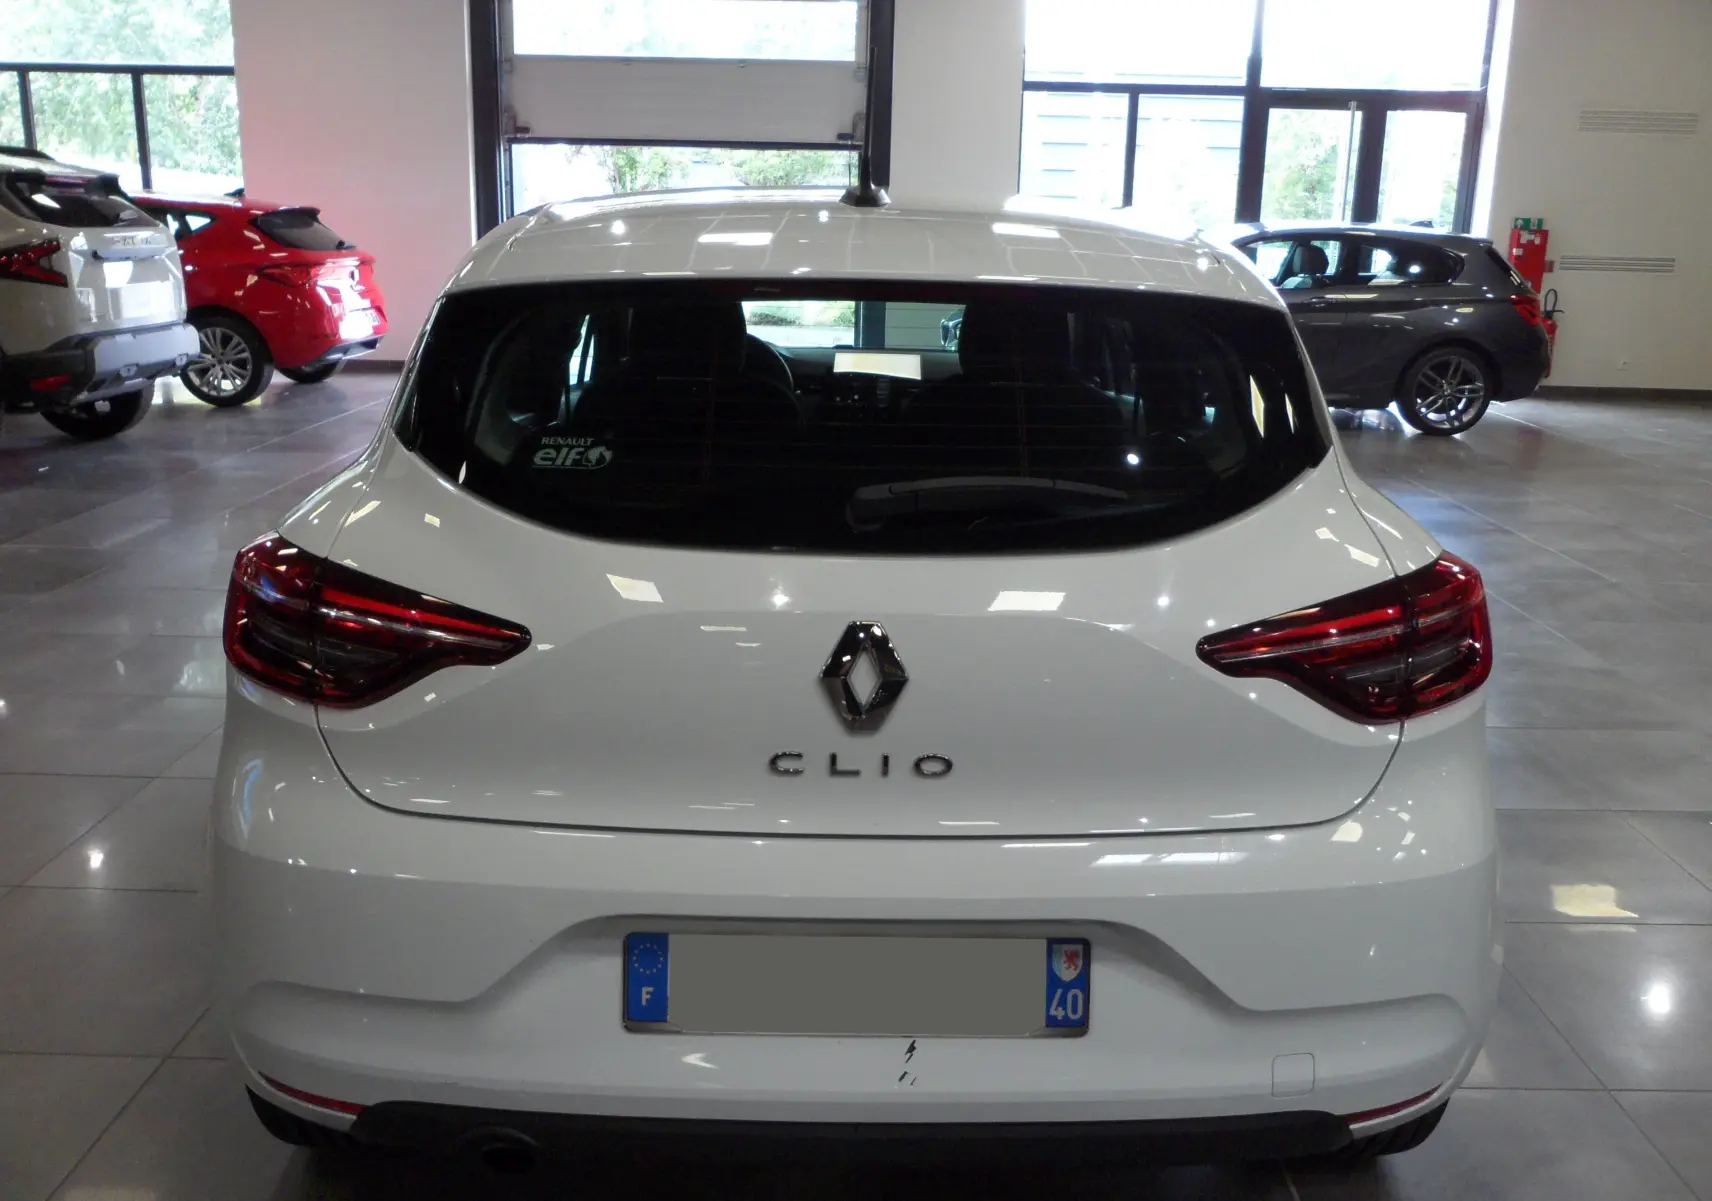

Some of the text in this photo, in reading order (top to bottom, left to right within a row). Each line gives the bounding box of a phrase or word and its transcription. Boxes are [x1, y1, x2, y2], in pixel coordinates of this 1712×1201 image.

[541, 437, 594, 446] RENAULT
[768, 751, 954, 777] CLIO
[641, 986, 655, 1006] F
[1048, 987, 1084, 1021] 40
